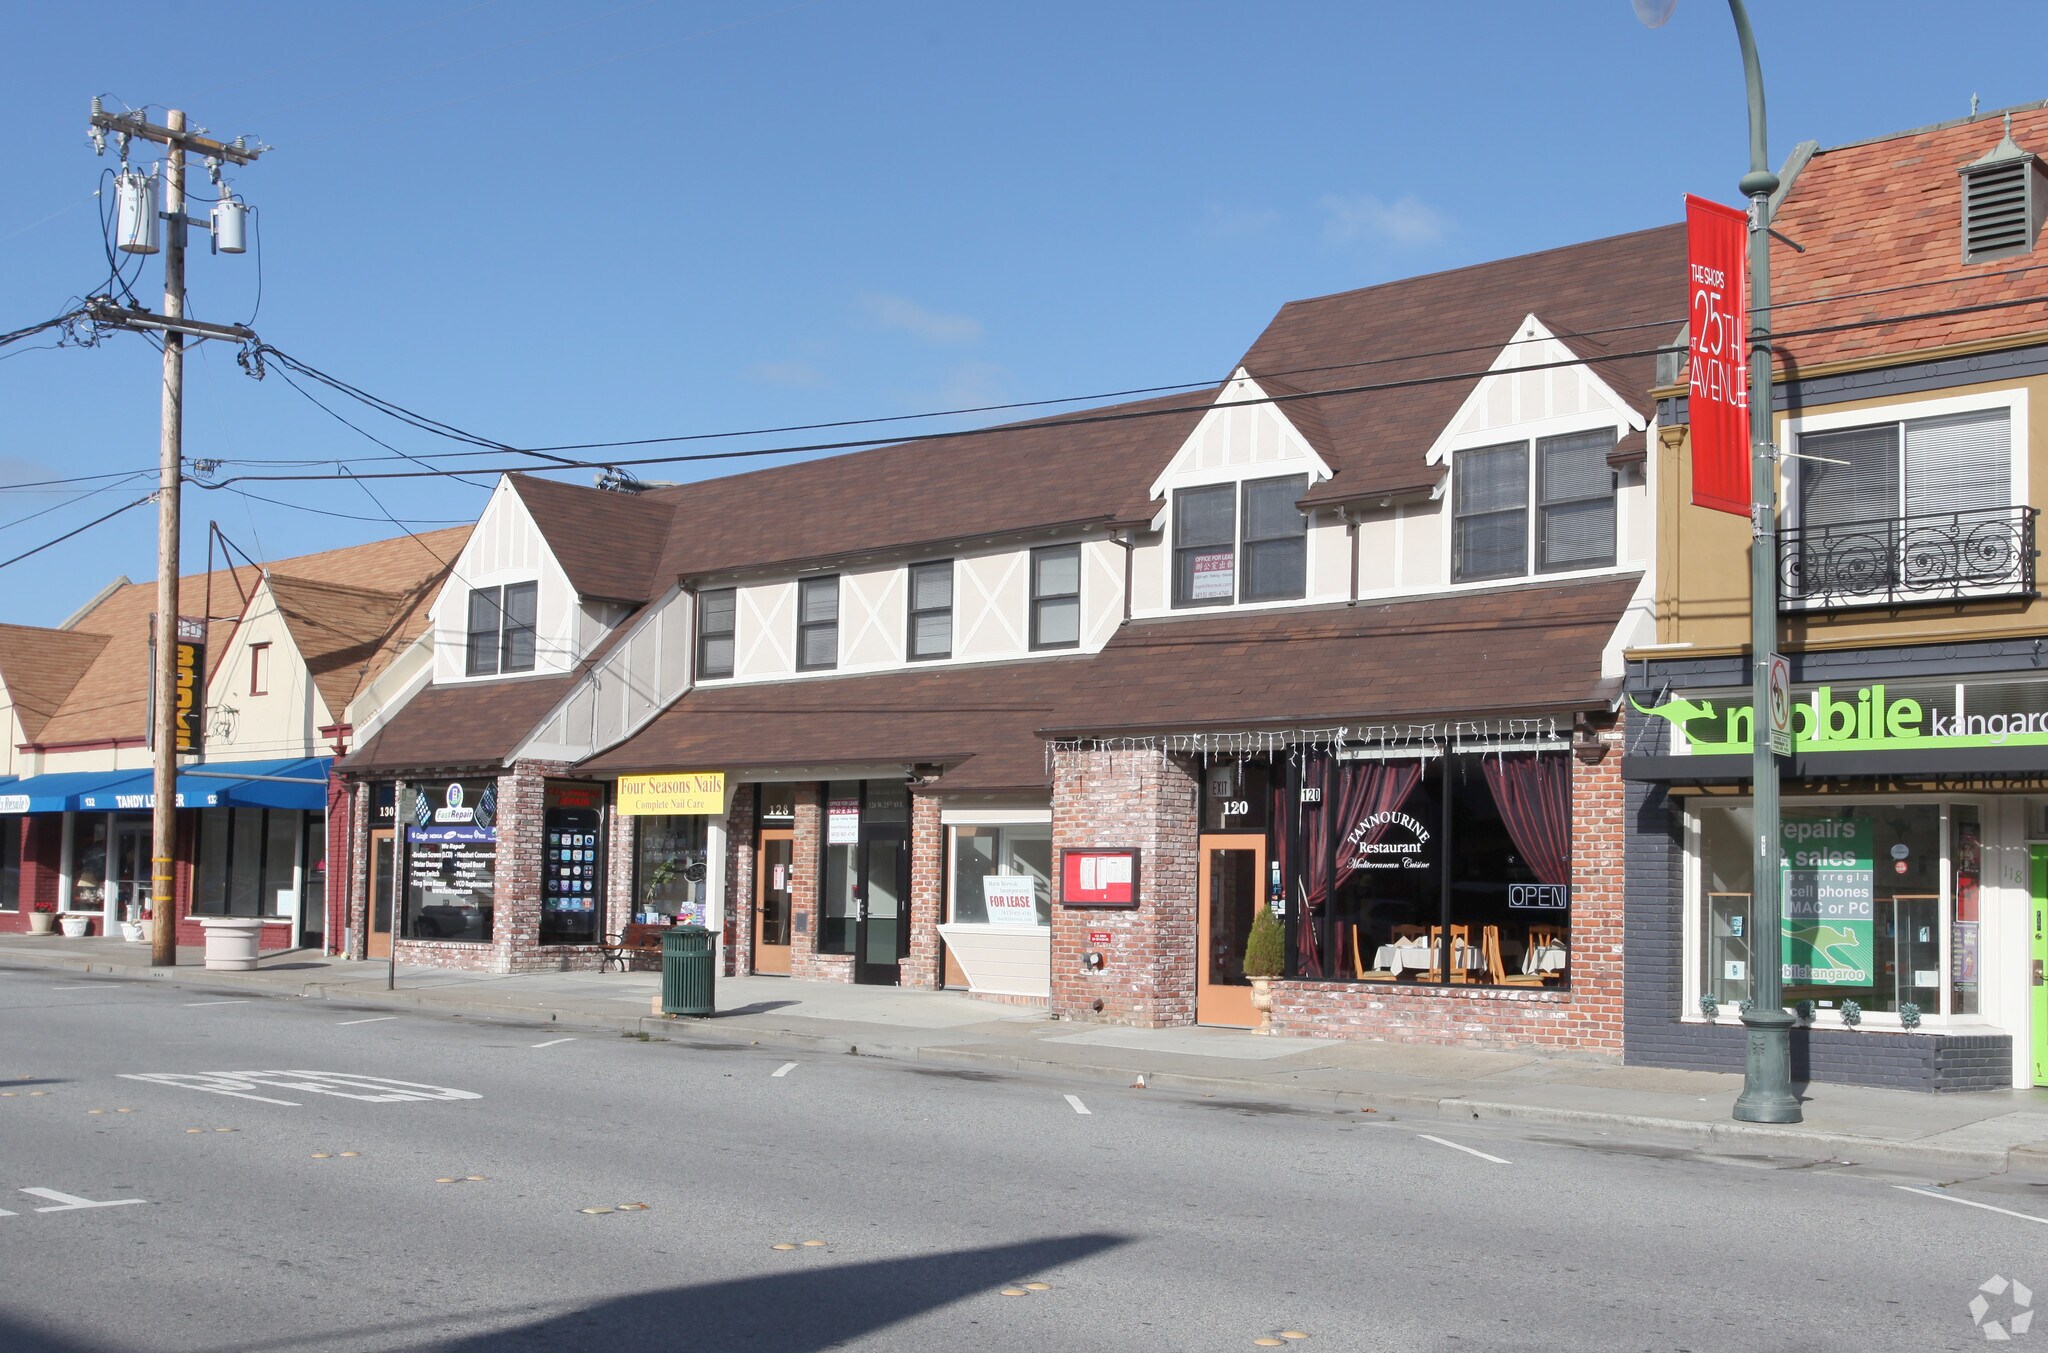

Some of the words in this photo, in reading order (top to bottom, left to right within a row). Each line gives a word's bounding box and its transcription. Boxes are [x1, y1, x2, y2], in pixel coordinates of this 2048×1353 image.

[1691, 264, 1704, 284] THE
[1704, 267, 1724, 289] SHOPS
[1695, 290, 1740, 362] 25TH
[1690, 356, 1746, 407] AVENUE
[621, 778, 646, 794] Four
[648, 777, 690, 794] Seasons
[694, 776, 722, 793] Nails
[1212, 781, 1228, 796] EXIT
[1302, 788, 1320, 800] 120
[85, 798, 95, 806] 132
[116, 795, 144, 808] TANDY
[635, 800, 668, 812] Complete
[671, 799, 684, 809] Nail
[686, 798, 704, 808] Care
[1224, 800, 1248, 815] 120
[380, 807, 394, 817] 130
[769, 804, 788, 816] 128
[1347, 811, 1430, 845] TANNOURINE
[1359, 842, 1422, 853] Restaurant
[1347, 857, 1400, 868] Mediterranean
[1402, 856, 1430, 868] Cuisine
[1795, 846, 1856, 867] sales
[1814, 872, 1868, 883] arregla
[2005, 865, 2022, 883] 118
[413, 880, 422, 888] Ring
[1512, 886, 1564, 906] OPEN
[1789, 885, 1812, 897] cell
[1818, 885, 1869, 900] phones
[990, 896, 1005, 908] FOR
[1006, 896, 1030, 908] LEASE
[1790, 902, 1824, 914] MAC
[1828, 904, 1844, 914] or
[1848, 902, 1870, 914] PC
[116, 1070, 483, 1106] PED
